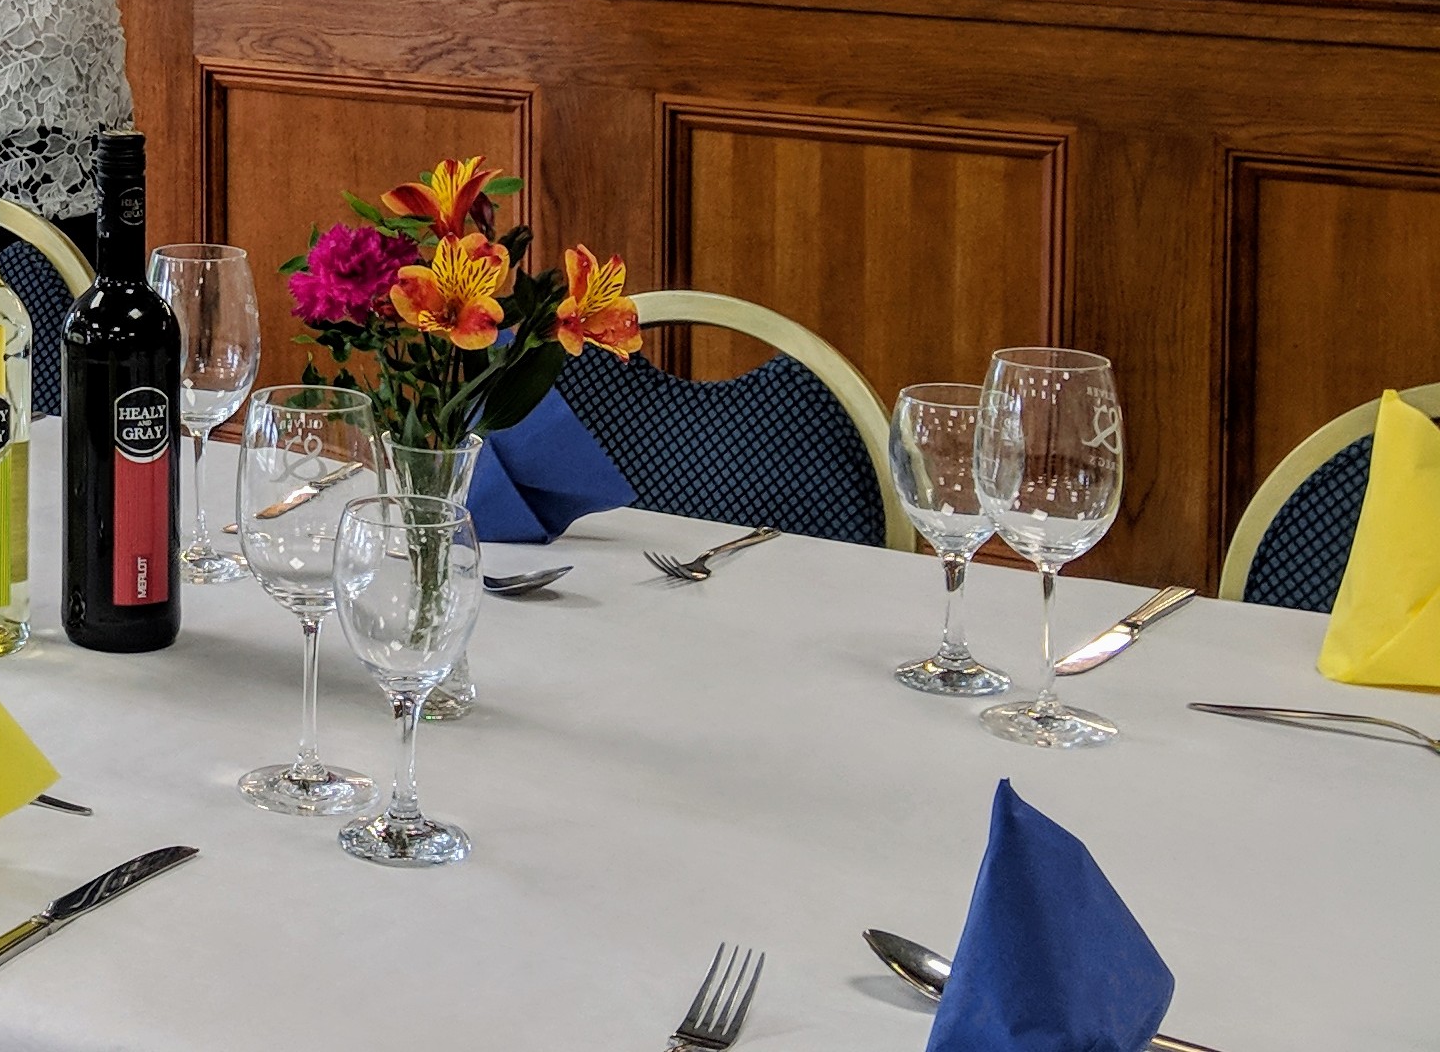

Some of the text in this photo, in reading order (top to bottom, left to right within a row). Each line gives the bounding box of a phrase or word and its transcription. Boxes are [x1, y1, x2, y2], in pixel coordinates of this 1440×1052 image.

[119, 404, 166, 420] HEALY
[122, 425, 163, 440] GRAY
[137, 556, 148, 598] MERLOT
